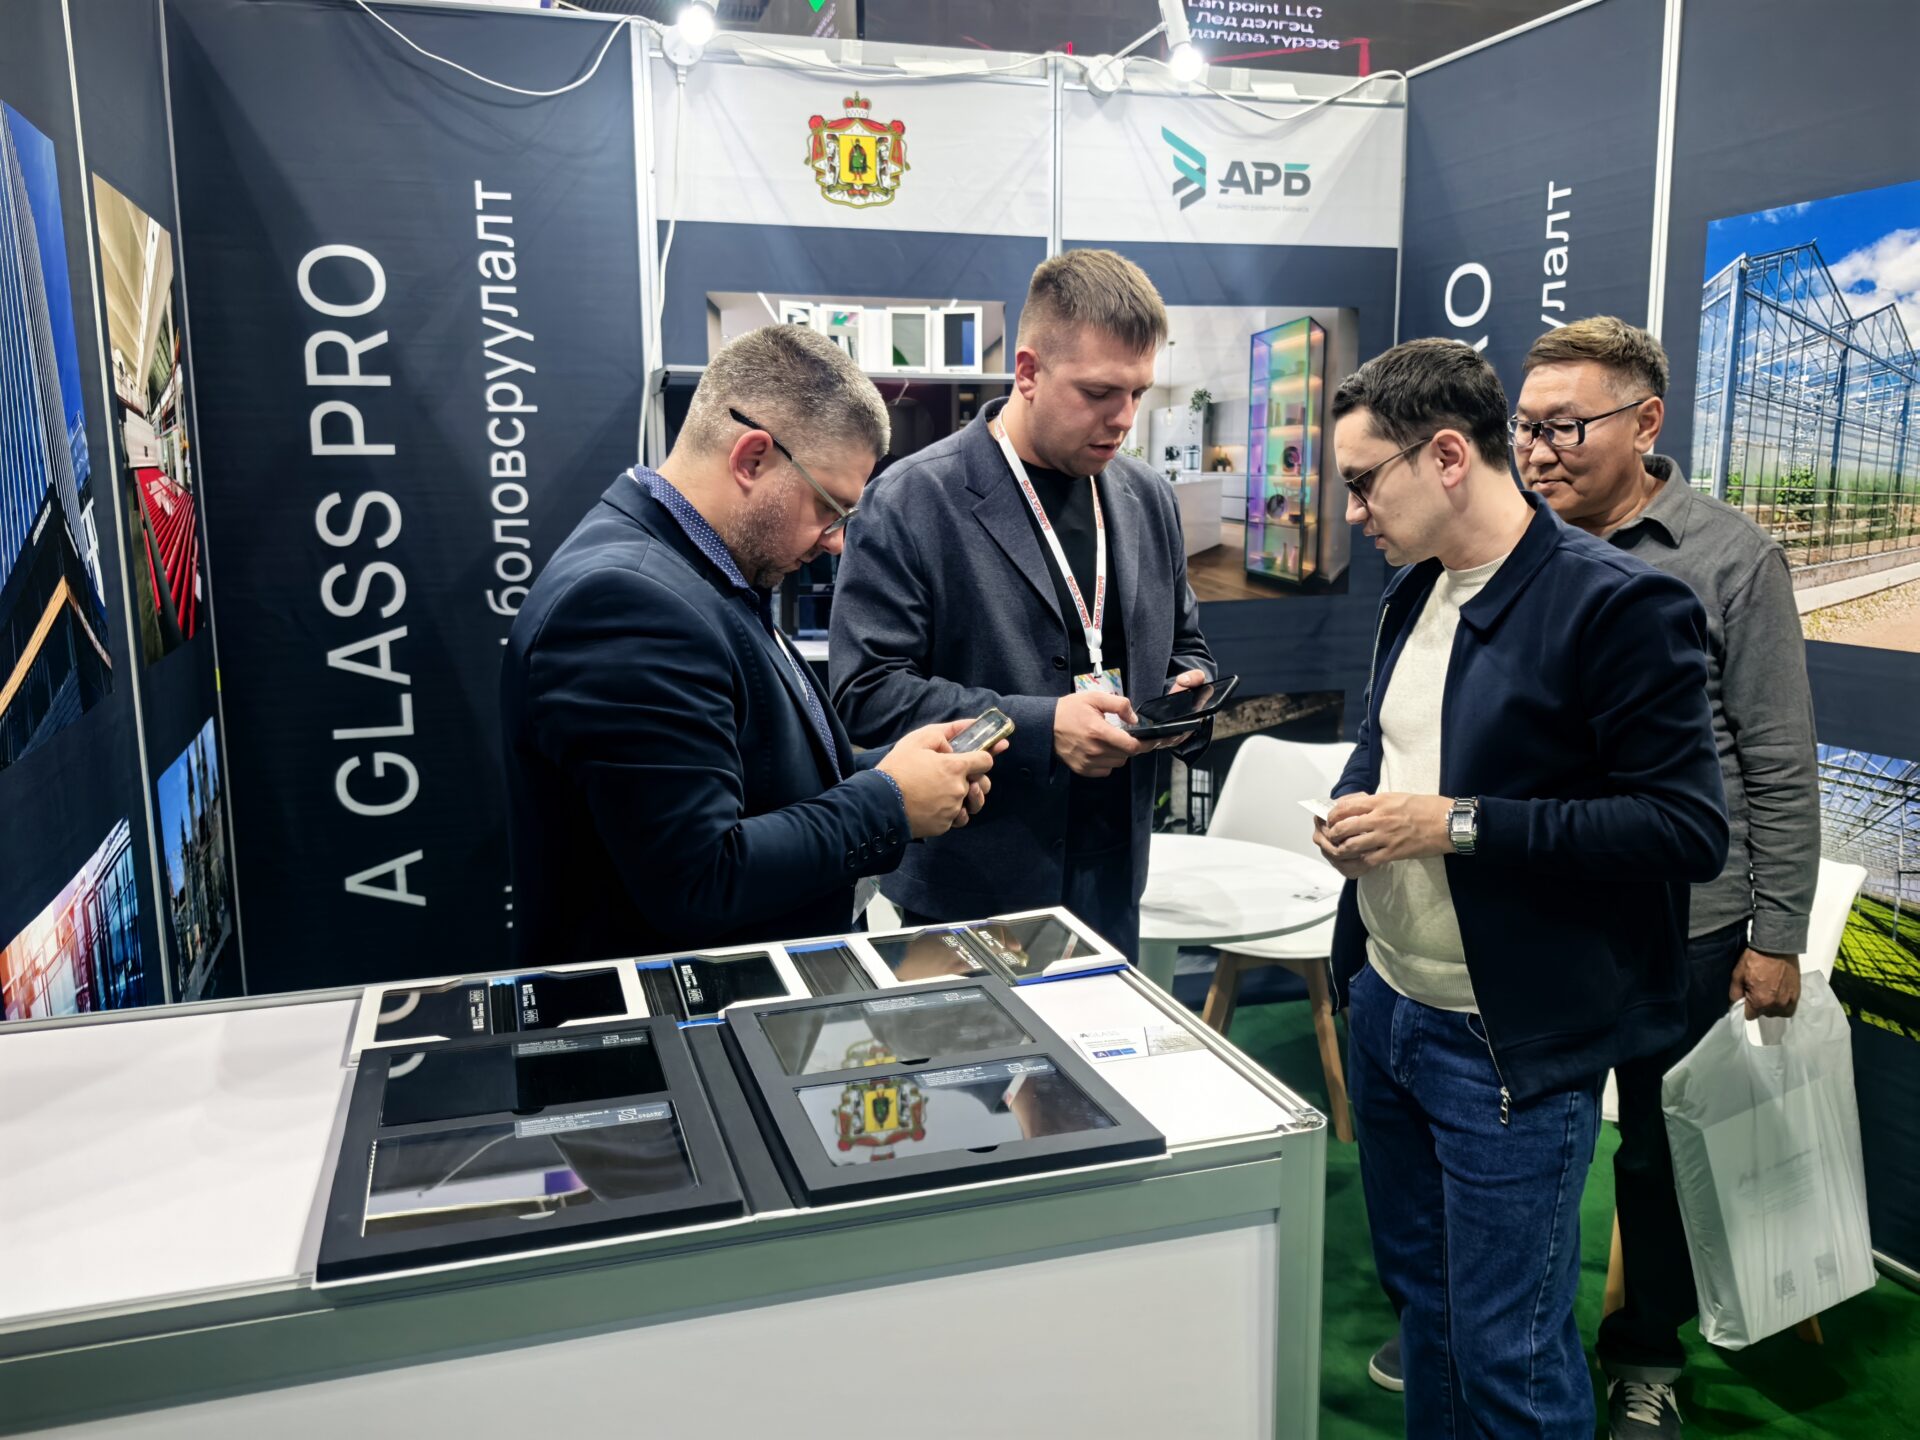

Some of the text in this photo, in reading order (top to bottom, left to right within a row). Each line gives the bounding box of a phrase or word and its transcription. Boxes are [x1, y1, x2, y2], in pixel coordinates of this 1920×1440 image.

[1229, 1, 1279, 15] point
[1285, 4, 1323, 18] LLC
[1196, 11, 1315, 34] Лед дэлгэц
[1218, 161, 1311, 197] АРБ
[297, 244, 396, 456] PRO
[474, 180, 539, 616] боловсруулалт
[1023, 480, 1037, 500] EXPO
[1067, 575, 1080, 597] EXPO
[1094, 608, 1102, 630] EXPO
[315, 490, 420, 816] GLASS
